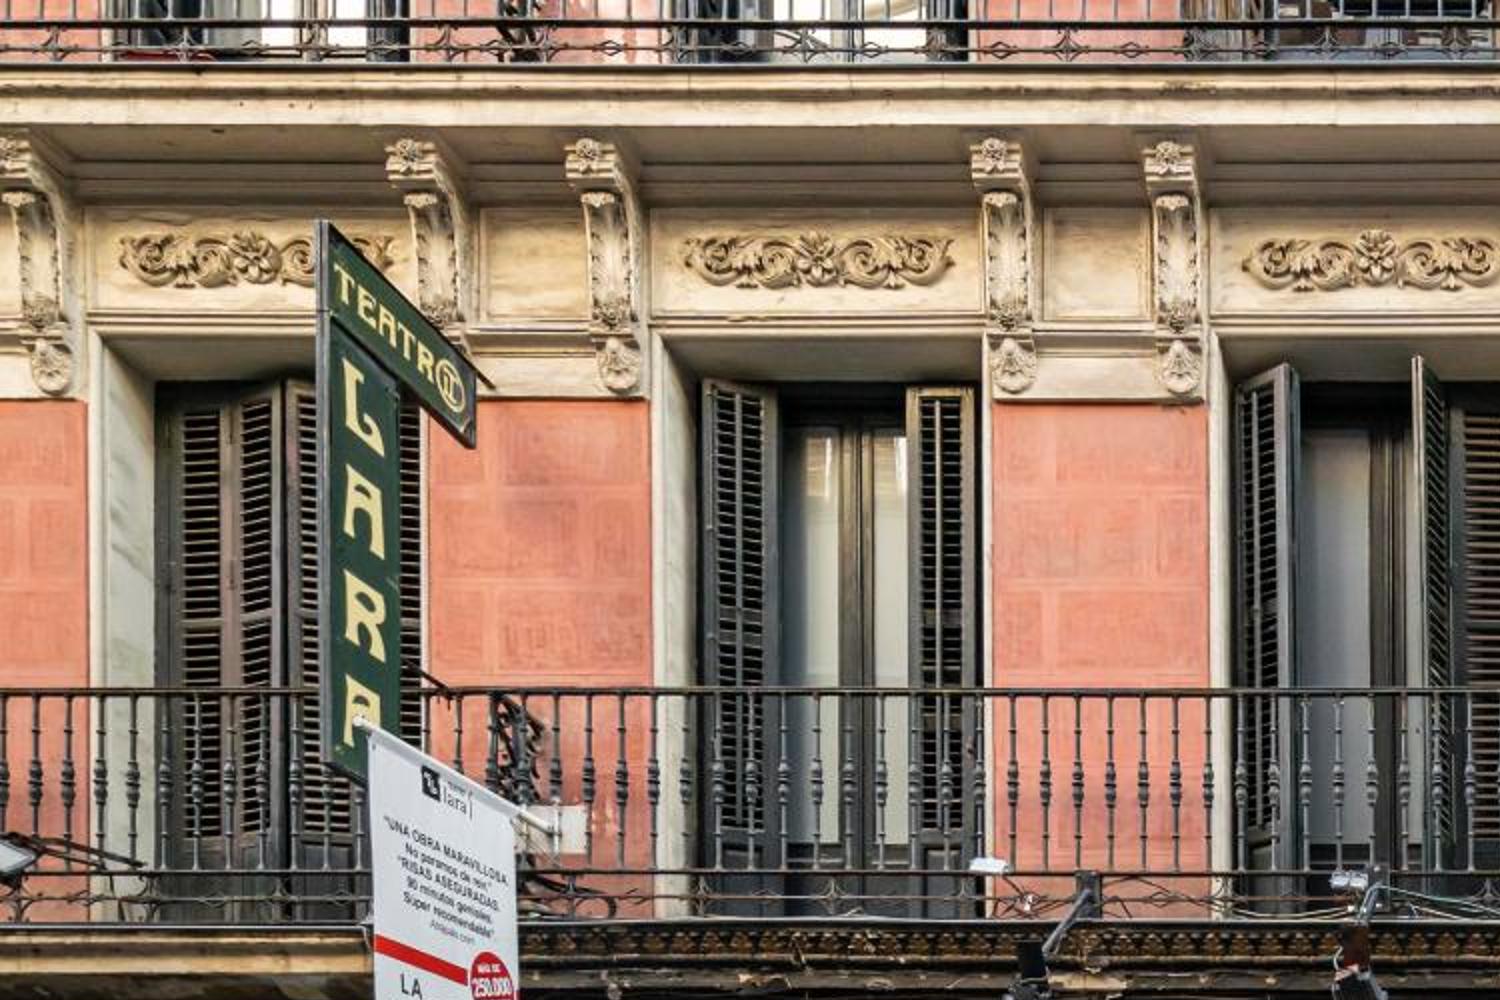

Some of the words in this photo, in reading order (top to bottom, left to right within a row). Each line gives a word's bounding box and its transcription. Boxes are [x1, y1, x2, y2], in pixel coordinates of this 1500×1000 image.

[333, 262, 468, 414] TEATRO
[342, 357, 388, 748] LARA
[412, 829, 440, 850] OBRA
[420, 885, 455, 907] minutos
[401, 973, 422, 1000] LA
